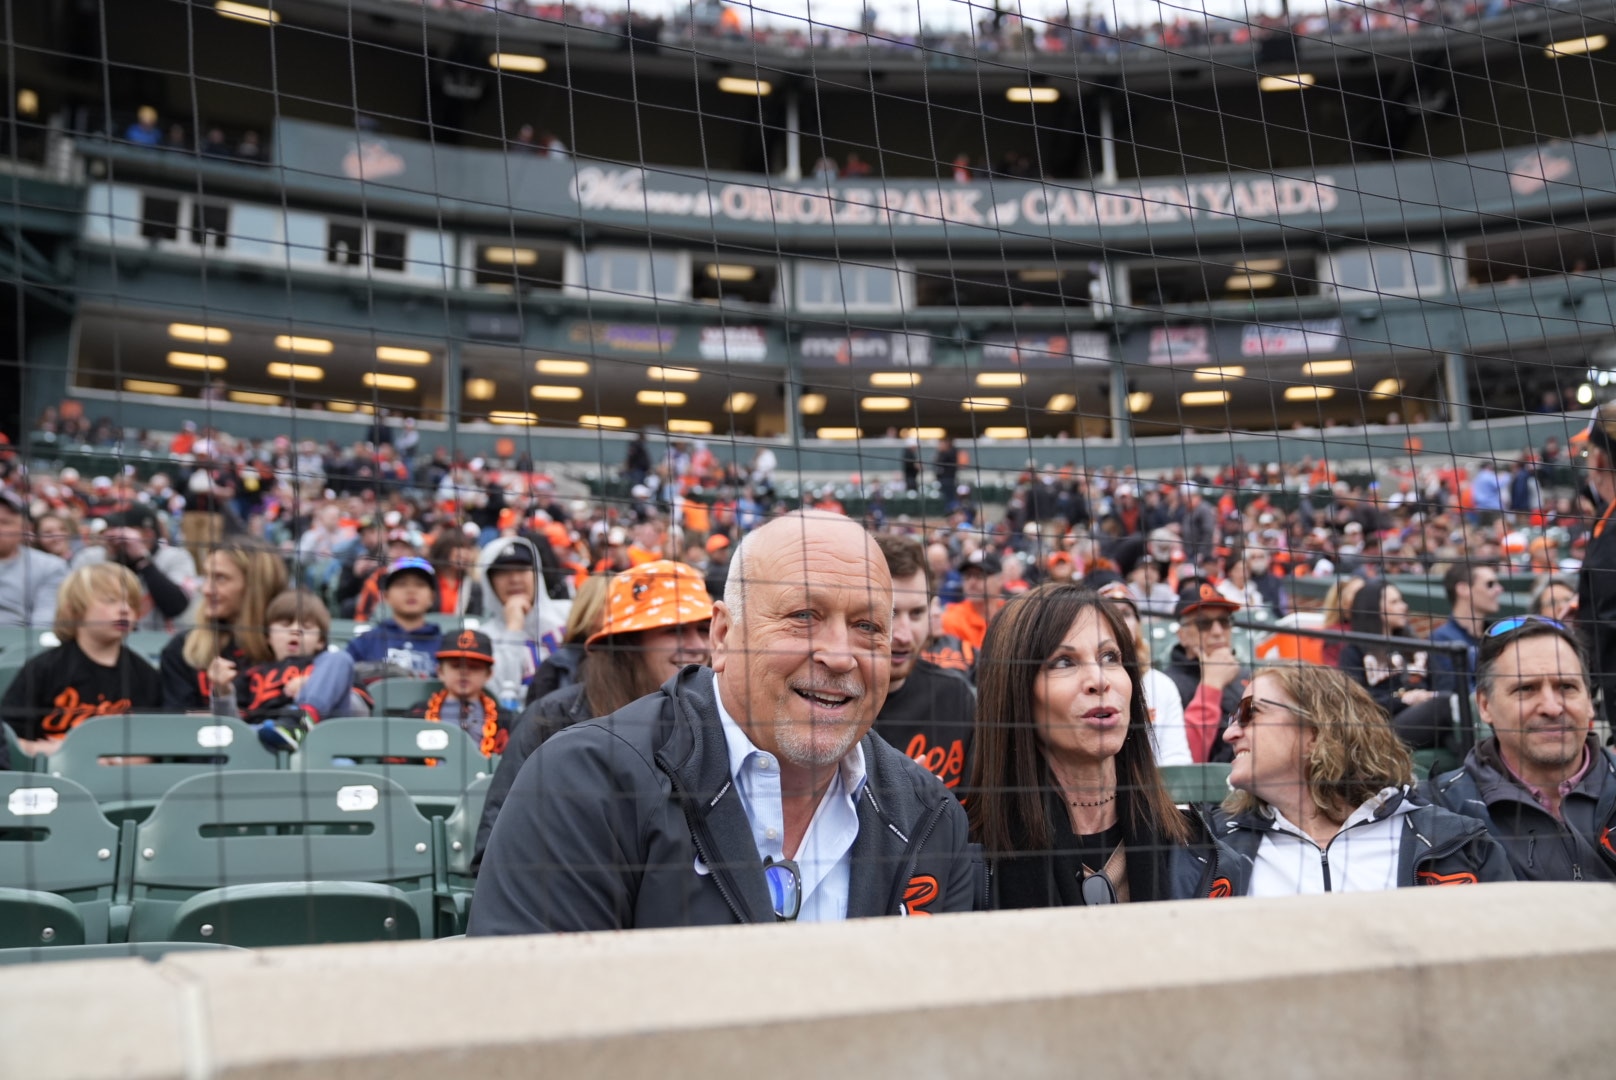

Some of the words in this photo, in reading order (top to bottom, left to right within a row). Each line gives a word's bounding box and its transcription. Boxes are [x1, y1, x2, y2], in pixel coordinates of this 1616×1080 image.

[720, 184, 873, 224] ORIOLE
[876, 188, 983, 226] PARK
[1022, 186, 1202, 226] CAMDEN
[1197, 174, 1338, 218] YARDS
[353, 789, 362, 807] 5
